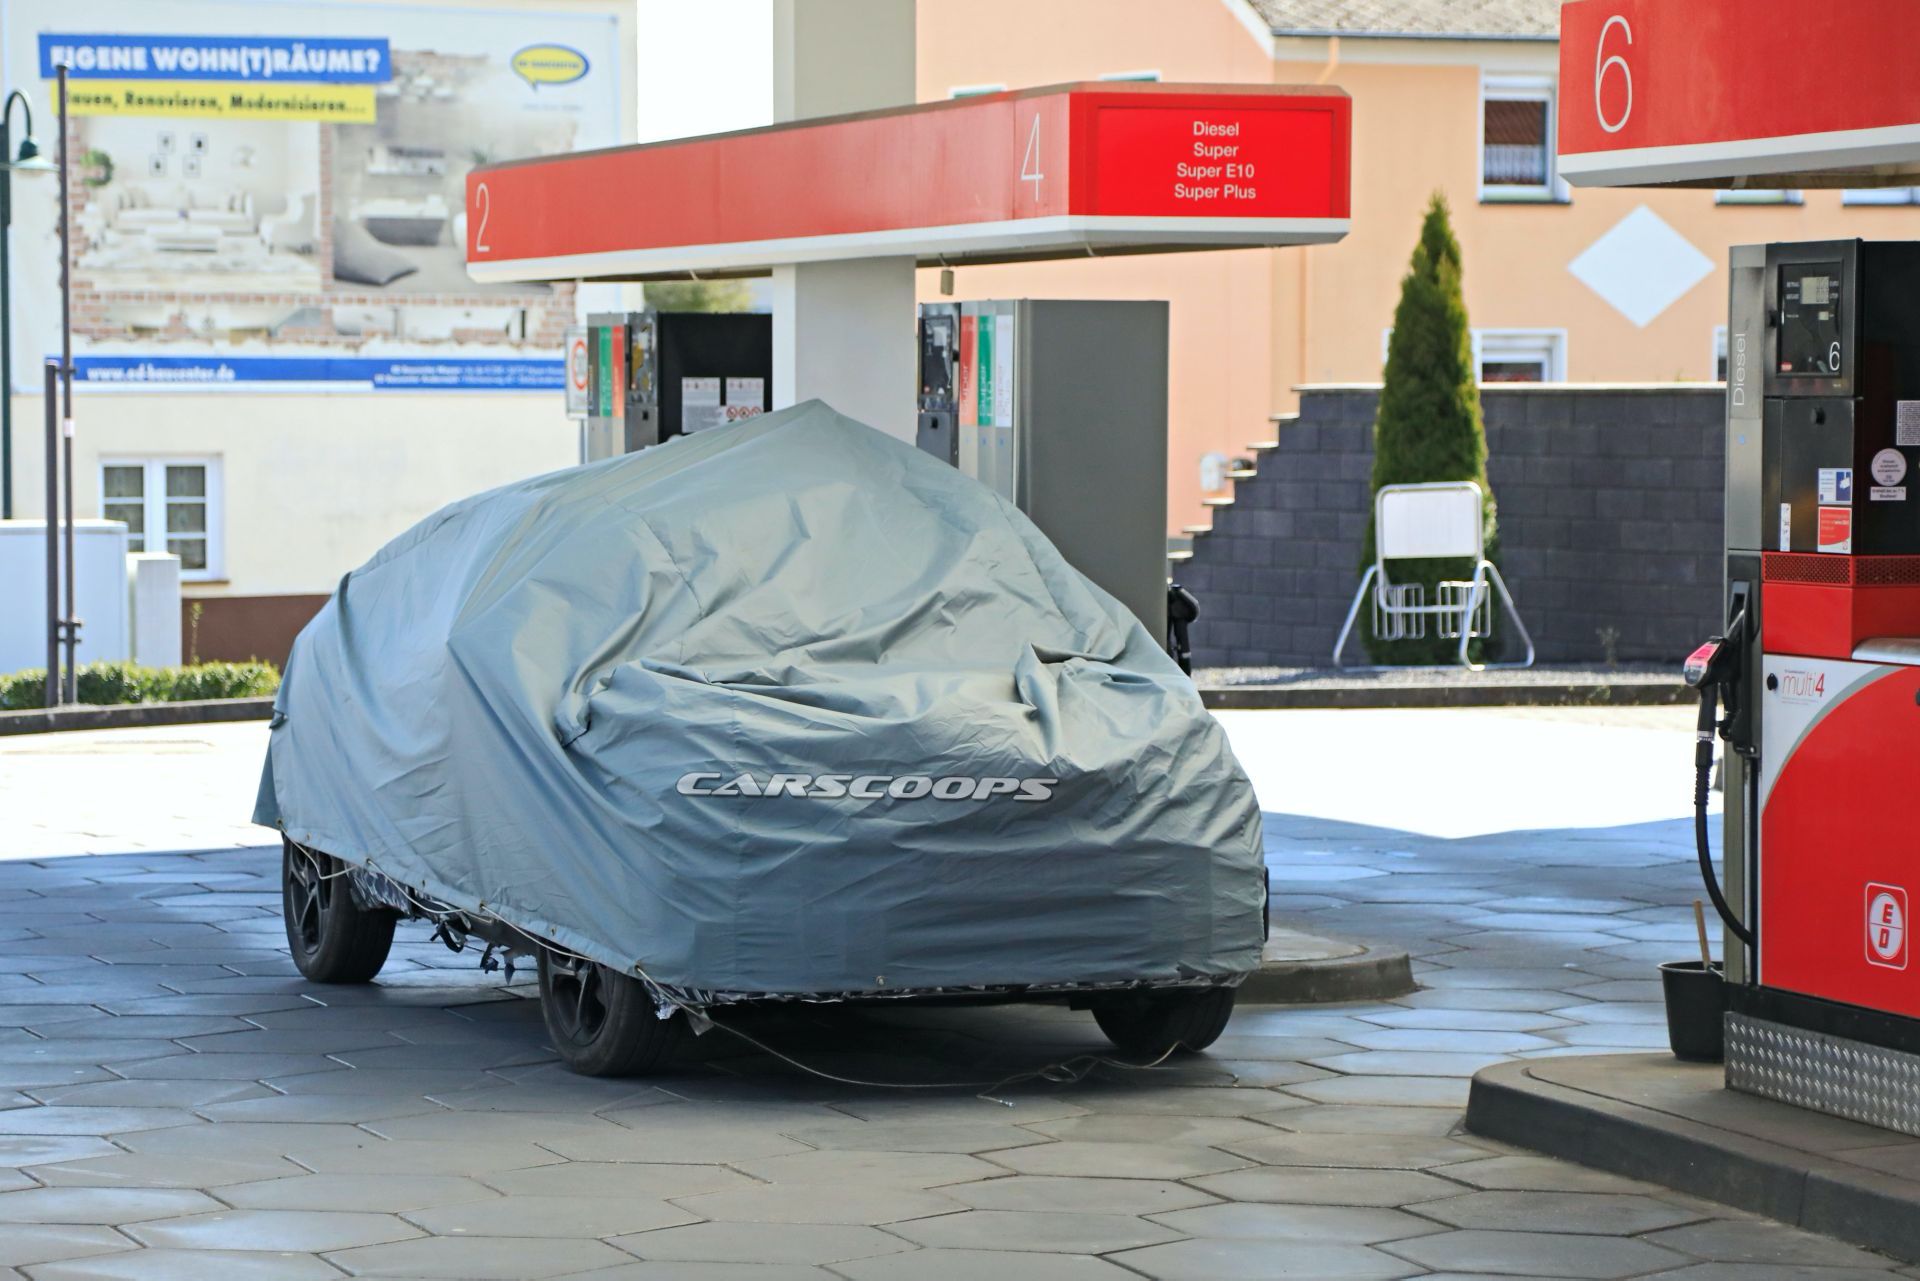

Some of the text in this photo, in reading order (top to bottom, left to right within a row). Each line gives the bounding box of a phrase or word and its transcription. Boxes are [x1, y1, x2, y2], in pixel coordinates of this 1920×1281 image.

[50, 43, 381, 78] EIGENE WOHN(T)RÄUME?
[1596, 15, 1632, 133] 6
[65, 91, 118, 110] auen,
[125, 90, 222, 111] Renovieren,
[1193, 121, 1239, 136] Diesel
[1021, 112, 1044, 202] 4
[1194, 142, 1239, 160] Super
[1177, 162, 1255, 180] Super E10
[1174, 183, 1256, 201] Super Plus
[476, 183, 490, 252] 2
[1733, 333, 1746, 406] Diesel
[1829, 341, 1840, 371] 6
